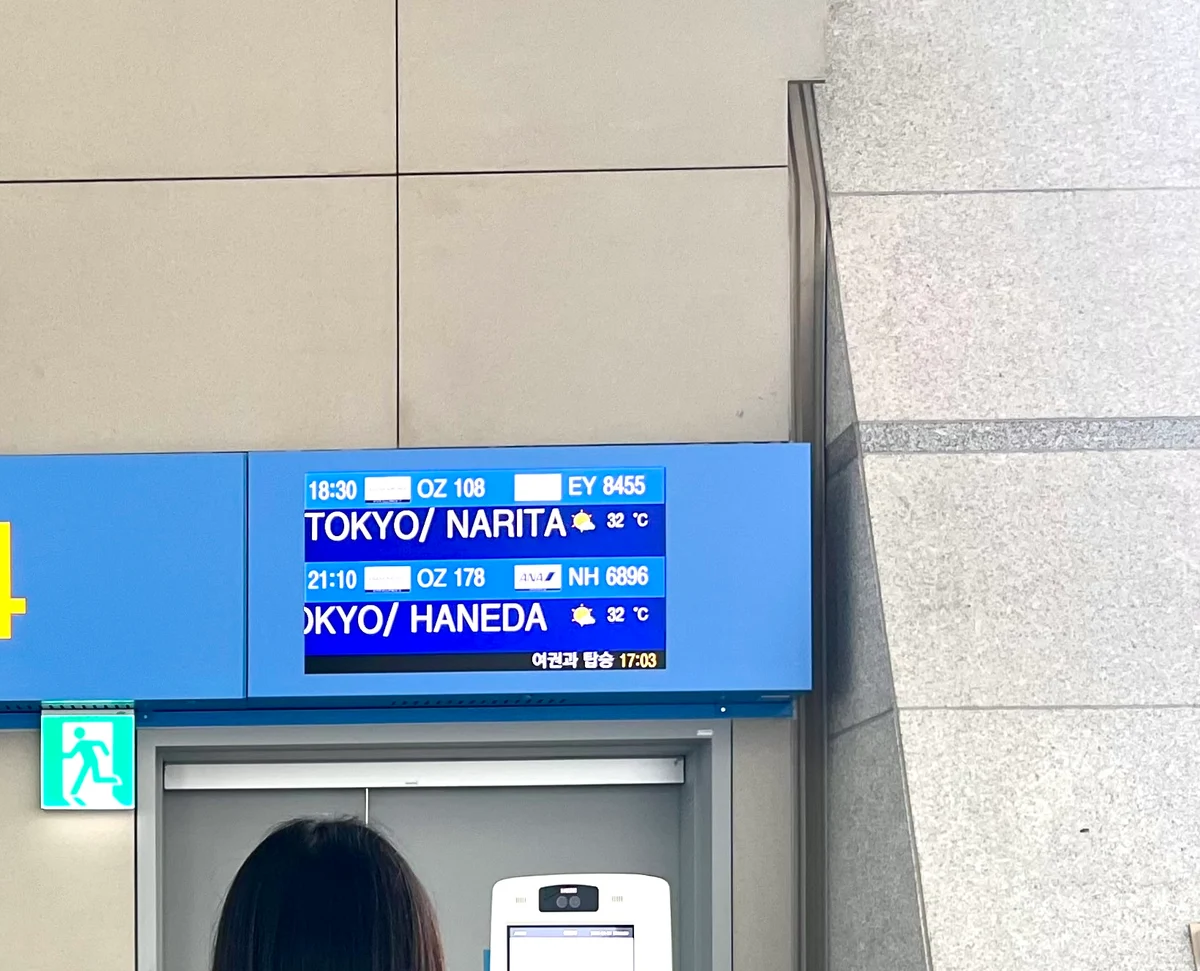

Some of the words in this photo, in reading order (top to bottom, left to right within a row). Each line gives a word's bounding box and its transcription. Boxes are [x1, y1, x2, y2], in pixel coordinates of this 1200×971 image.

[309, 479, 357, 500] 18:30
[417, 479, 447, 498] OZ
[453, 477, 486, 497] 108
[568, 476, 597, 495] EY
[602, 474, 646, 496] 8455
[304, 507, 436, 543] TOKYO/
[446, 508, 568, 539] NARITA
[607, 513, 625, 528] 32
[307, 570, 357, 590] 21:10
[417, 568, 447, 588] OZ
[453, 566, 486, 587] 178
[568, 567, 599, 586] NH
[605, 565, 649, 587] 6896
[410, 602, 548, 633] HANEDA
[607, 607, 625, 622] 32
[531, 652, 578, 669] 여권과
[583, 651, 615, 669] 탑승
[620, 652, 657, 669] 17:03
